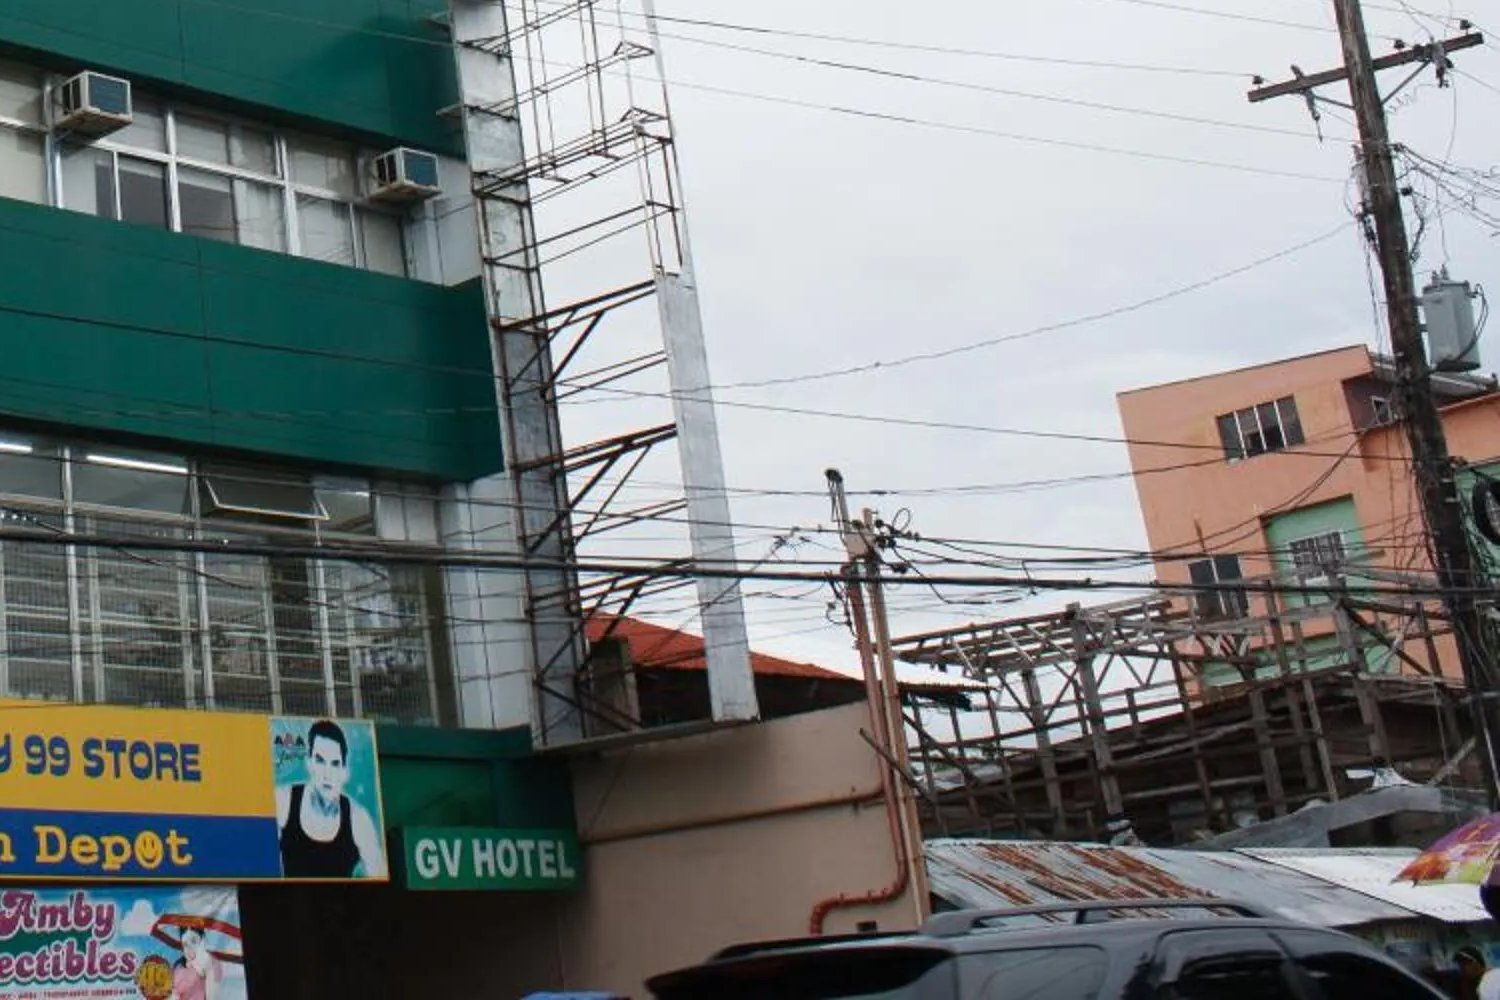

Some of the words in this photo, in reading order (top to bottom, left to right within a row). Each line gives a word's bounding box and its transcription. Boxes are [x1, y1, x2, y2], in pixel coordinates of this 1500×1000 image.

[24, 735, 70, 777] 99
[83, 740, 202, 782] STORE
[414, 838, 462, 878] GV
[471, 838, 576, 879] HOTEL
